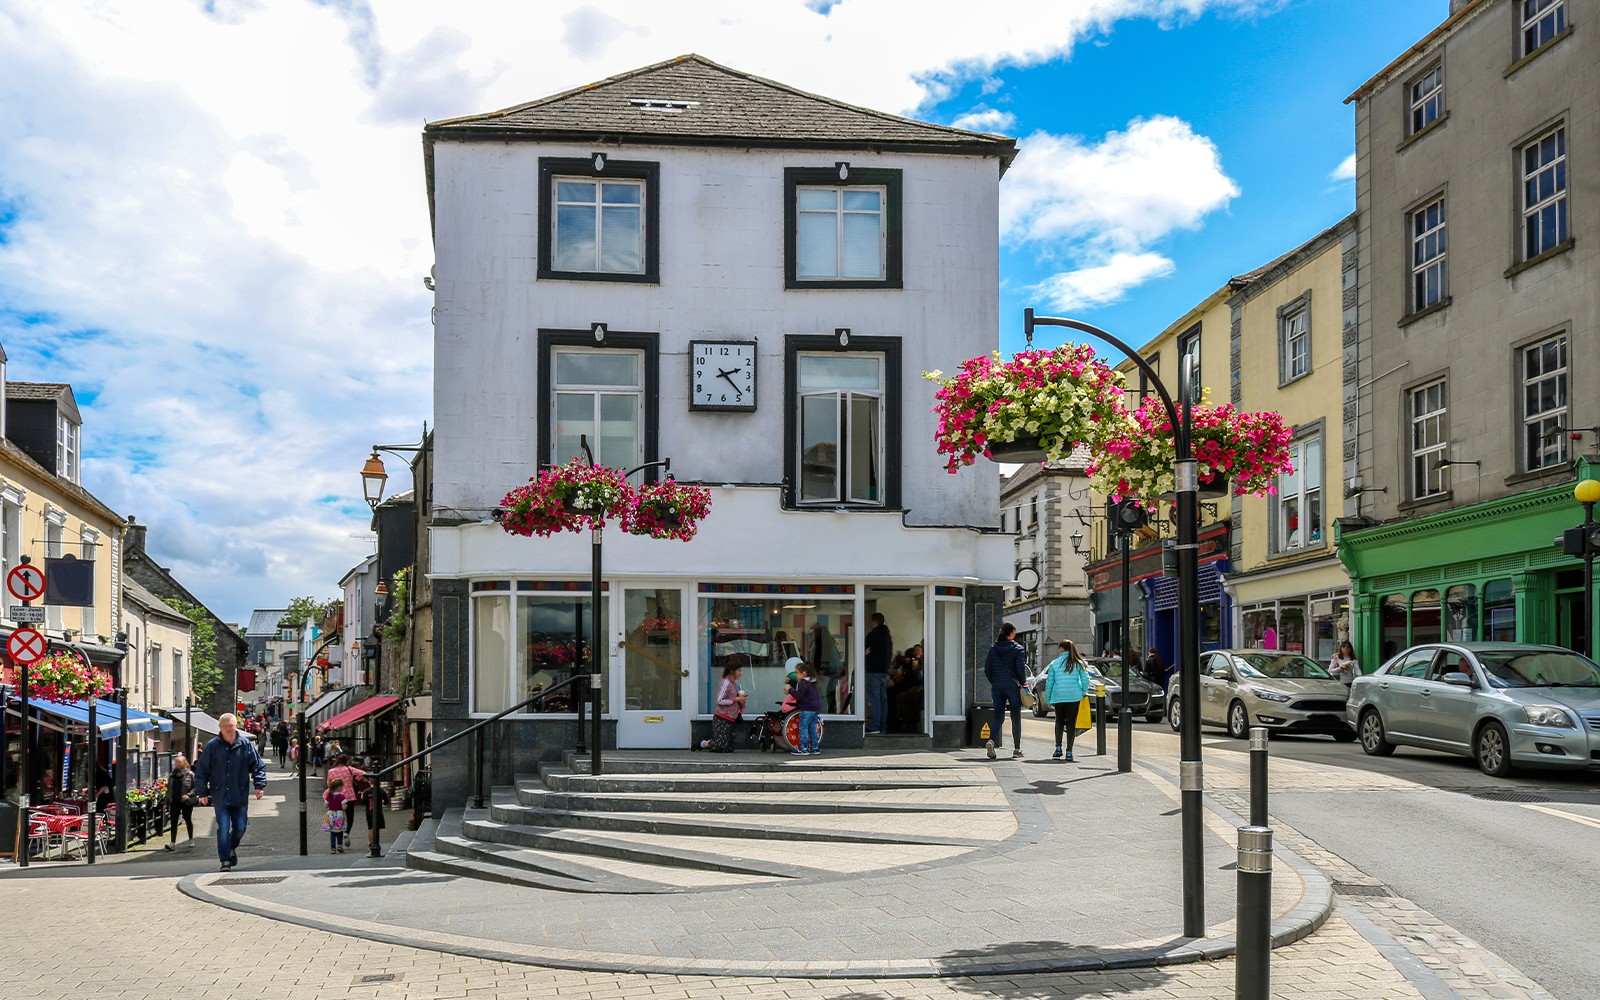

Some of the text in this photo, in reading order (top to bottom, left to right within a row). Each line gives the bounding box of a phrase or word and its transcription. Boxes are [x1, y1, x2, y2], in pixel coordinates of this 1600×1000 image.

[705, 347, 713, 356] 11
[720, 347, 729, 356] 12
[738, 348, 740, 356] 1
[696, 357, 706, 365] 10
[746, 358, 751, 366] 2
[696, 370, 702, 378] 9
[746, 372, 751, 380] 3
[696, 384, 702, 393] 8
[746, 385, 751, 393] 4
[707, 394, 712, 402] 7
[720, 394, 726, 402] 6
[736, 394, 741, 402] 5
